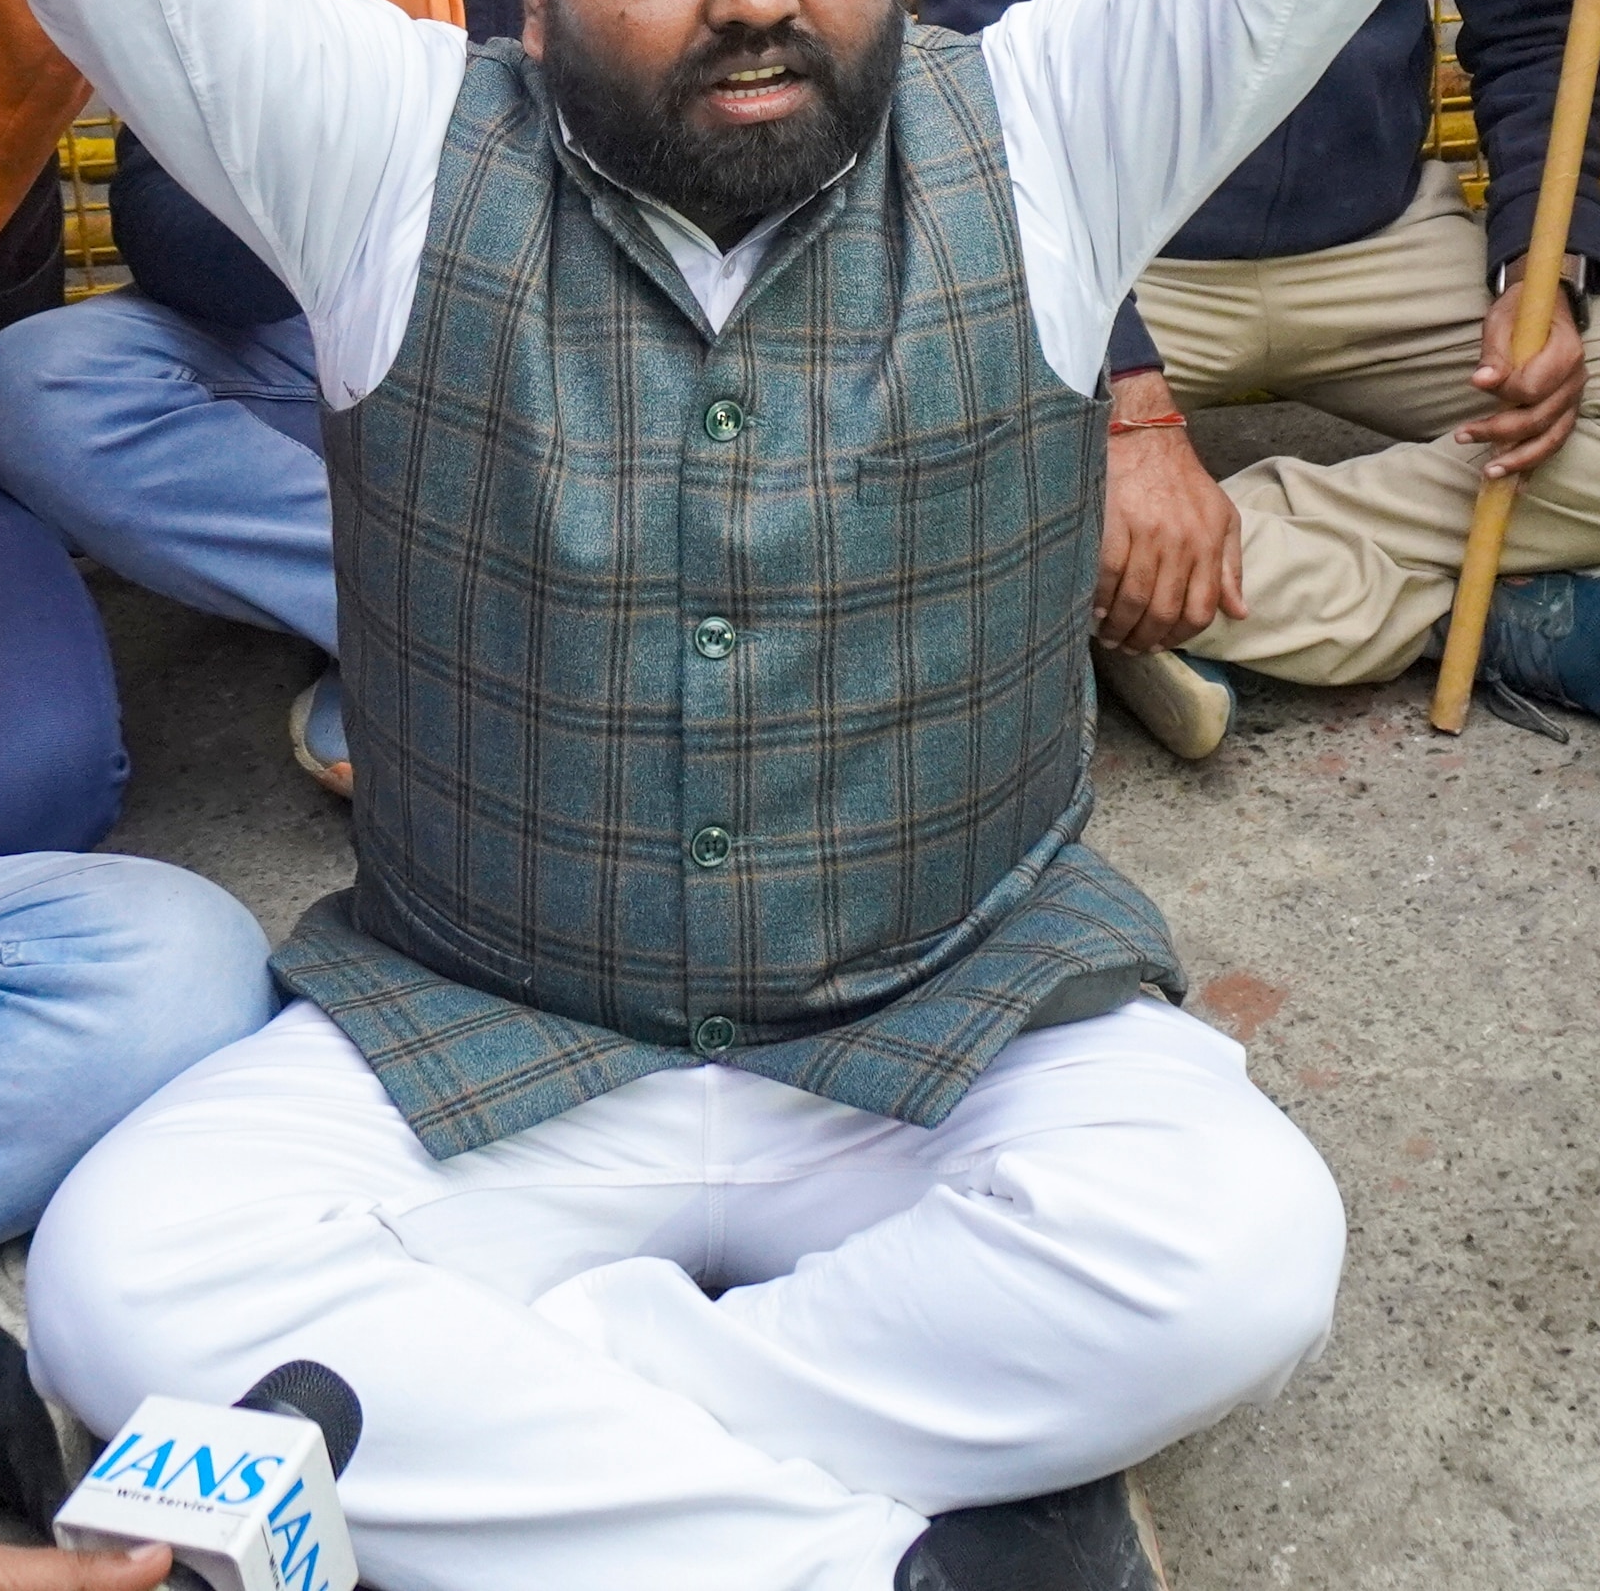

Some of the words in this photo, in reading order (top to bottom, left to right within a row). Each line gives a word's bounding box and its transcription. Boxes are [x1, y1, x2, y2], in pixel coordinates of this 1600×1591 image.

[91, 1433, 285, 1505] IANS
[116, 1488, 151, 1503] Wire
[157, 1496, 215, 1514] Service
